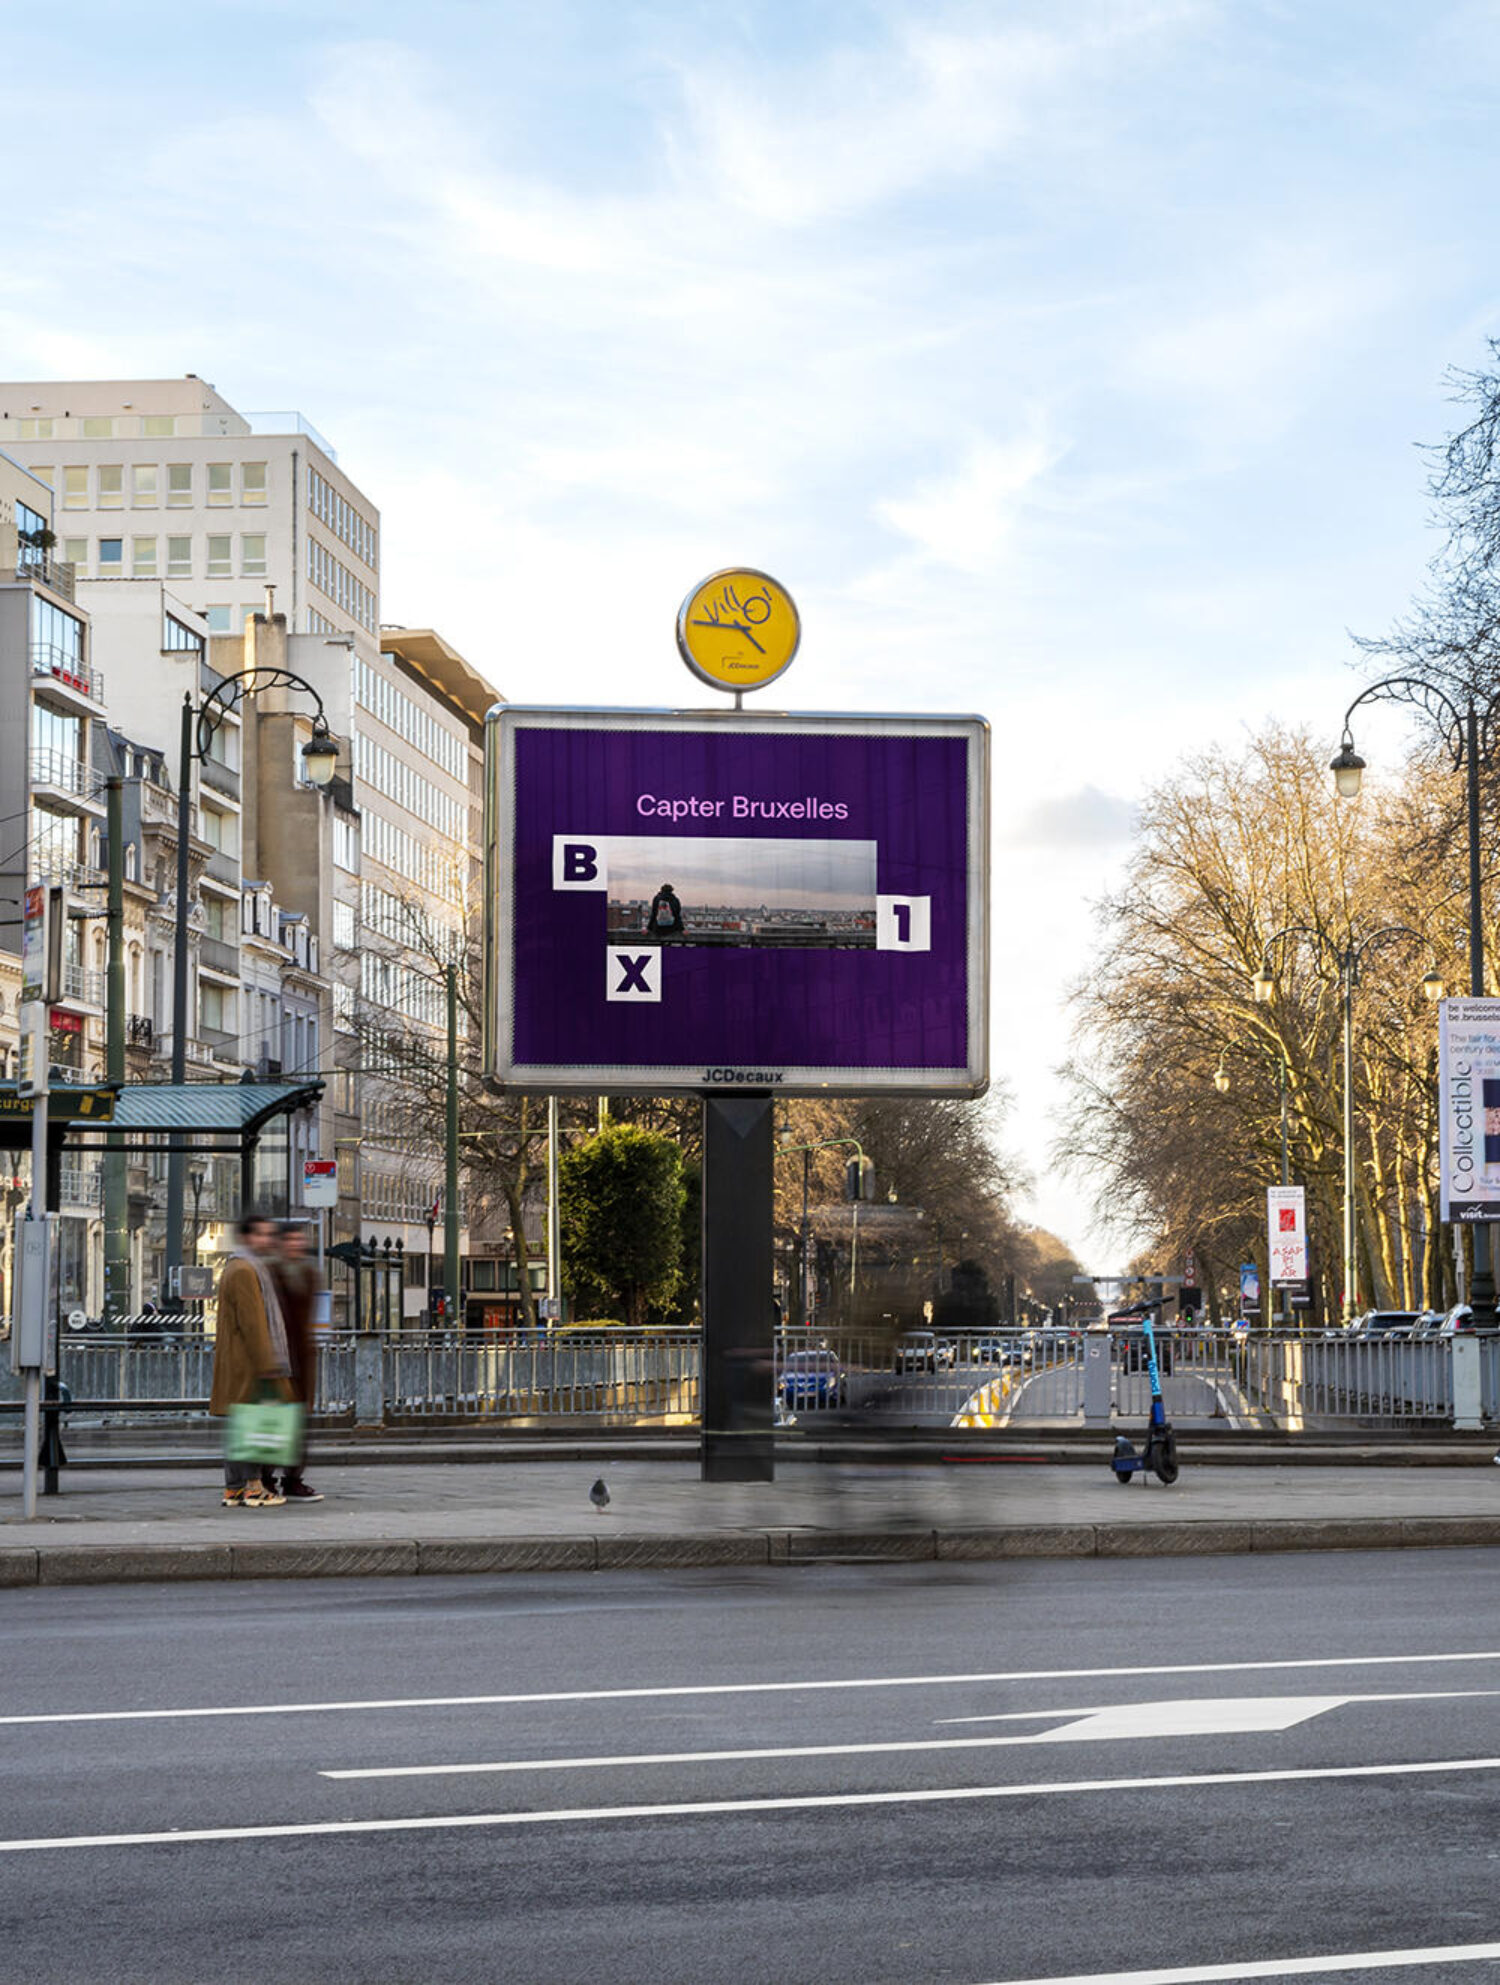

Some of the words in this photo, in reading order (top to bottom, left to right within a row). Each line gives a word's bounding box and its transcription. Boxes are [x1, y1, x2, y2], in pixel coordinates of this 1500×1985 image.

[636, 794, 725, 822] Capter
[732, 795, 849, 820] Bruxelles
[563, 843, 599, 882] B
[892, 903, 912, 943] 1
[615, 954, 653, 993] X
[702, 1068, 783, 1083] JCDecaux
[1451, 1060, 1474, 1193] Collectible
